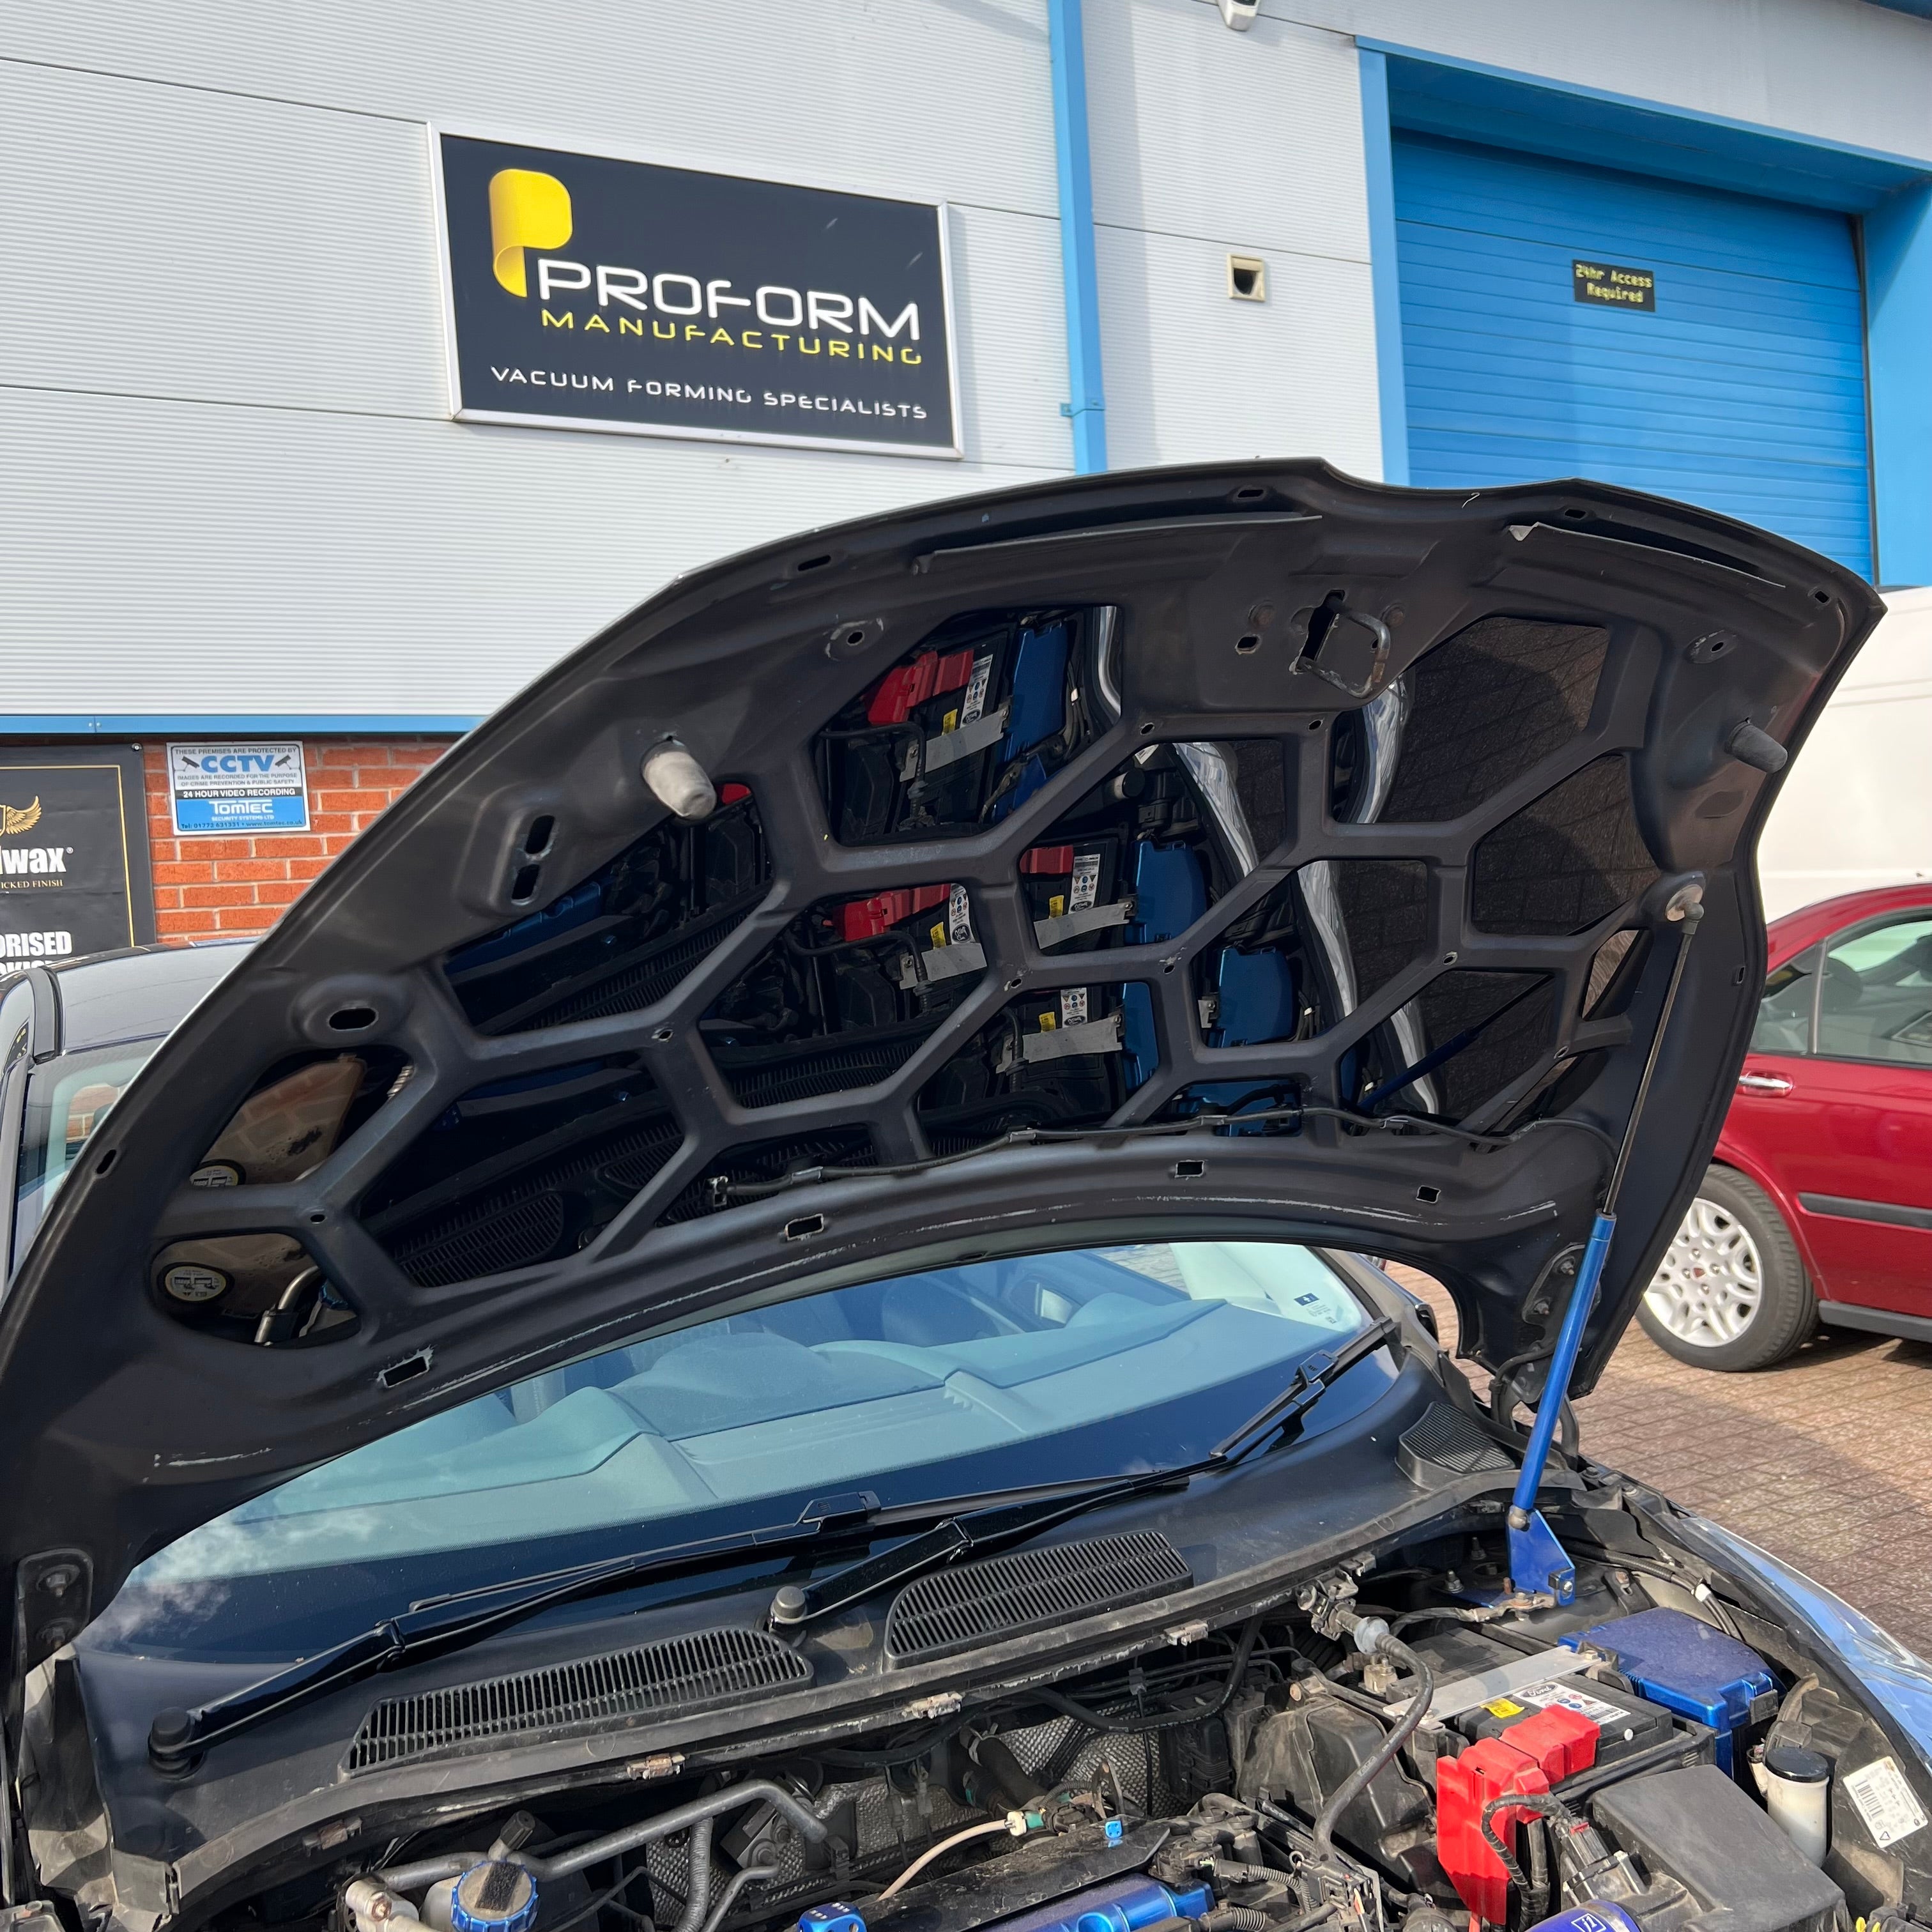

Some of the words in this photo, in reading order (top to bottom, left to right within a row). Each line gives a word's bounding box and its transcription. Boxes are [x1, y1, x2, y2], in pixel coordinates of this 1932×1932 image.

[1610, 270, 1652, 288] Access
[538, 257, 921, 342] PROFORM
[1587, 282, 1643, 303] Required
[540, 309, 923, 365] MANUFACTURING
[490, 366, 614, 391] VACUUM
[627, 379, 752, 404] FORMING
[763, 391, 927, 420] SPECIALISTS
[201, 755, 275, 772] CCTV
[33, 879, 63, 887] FINISH
